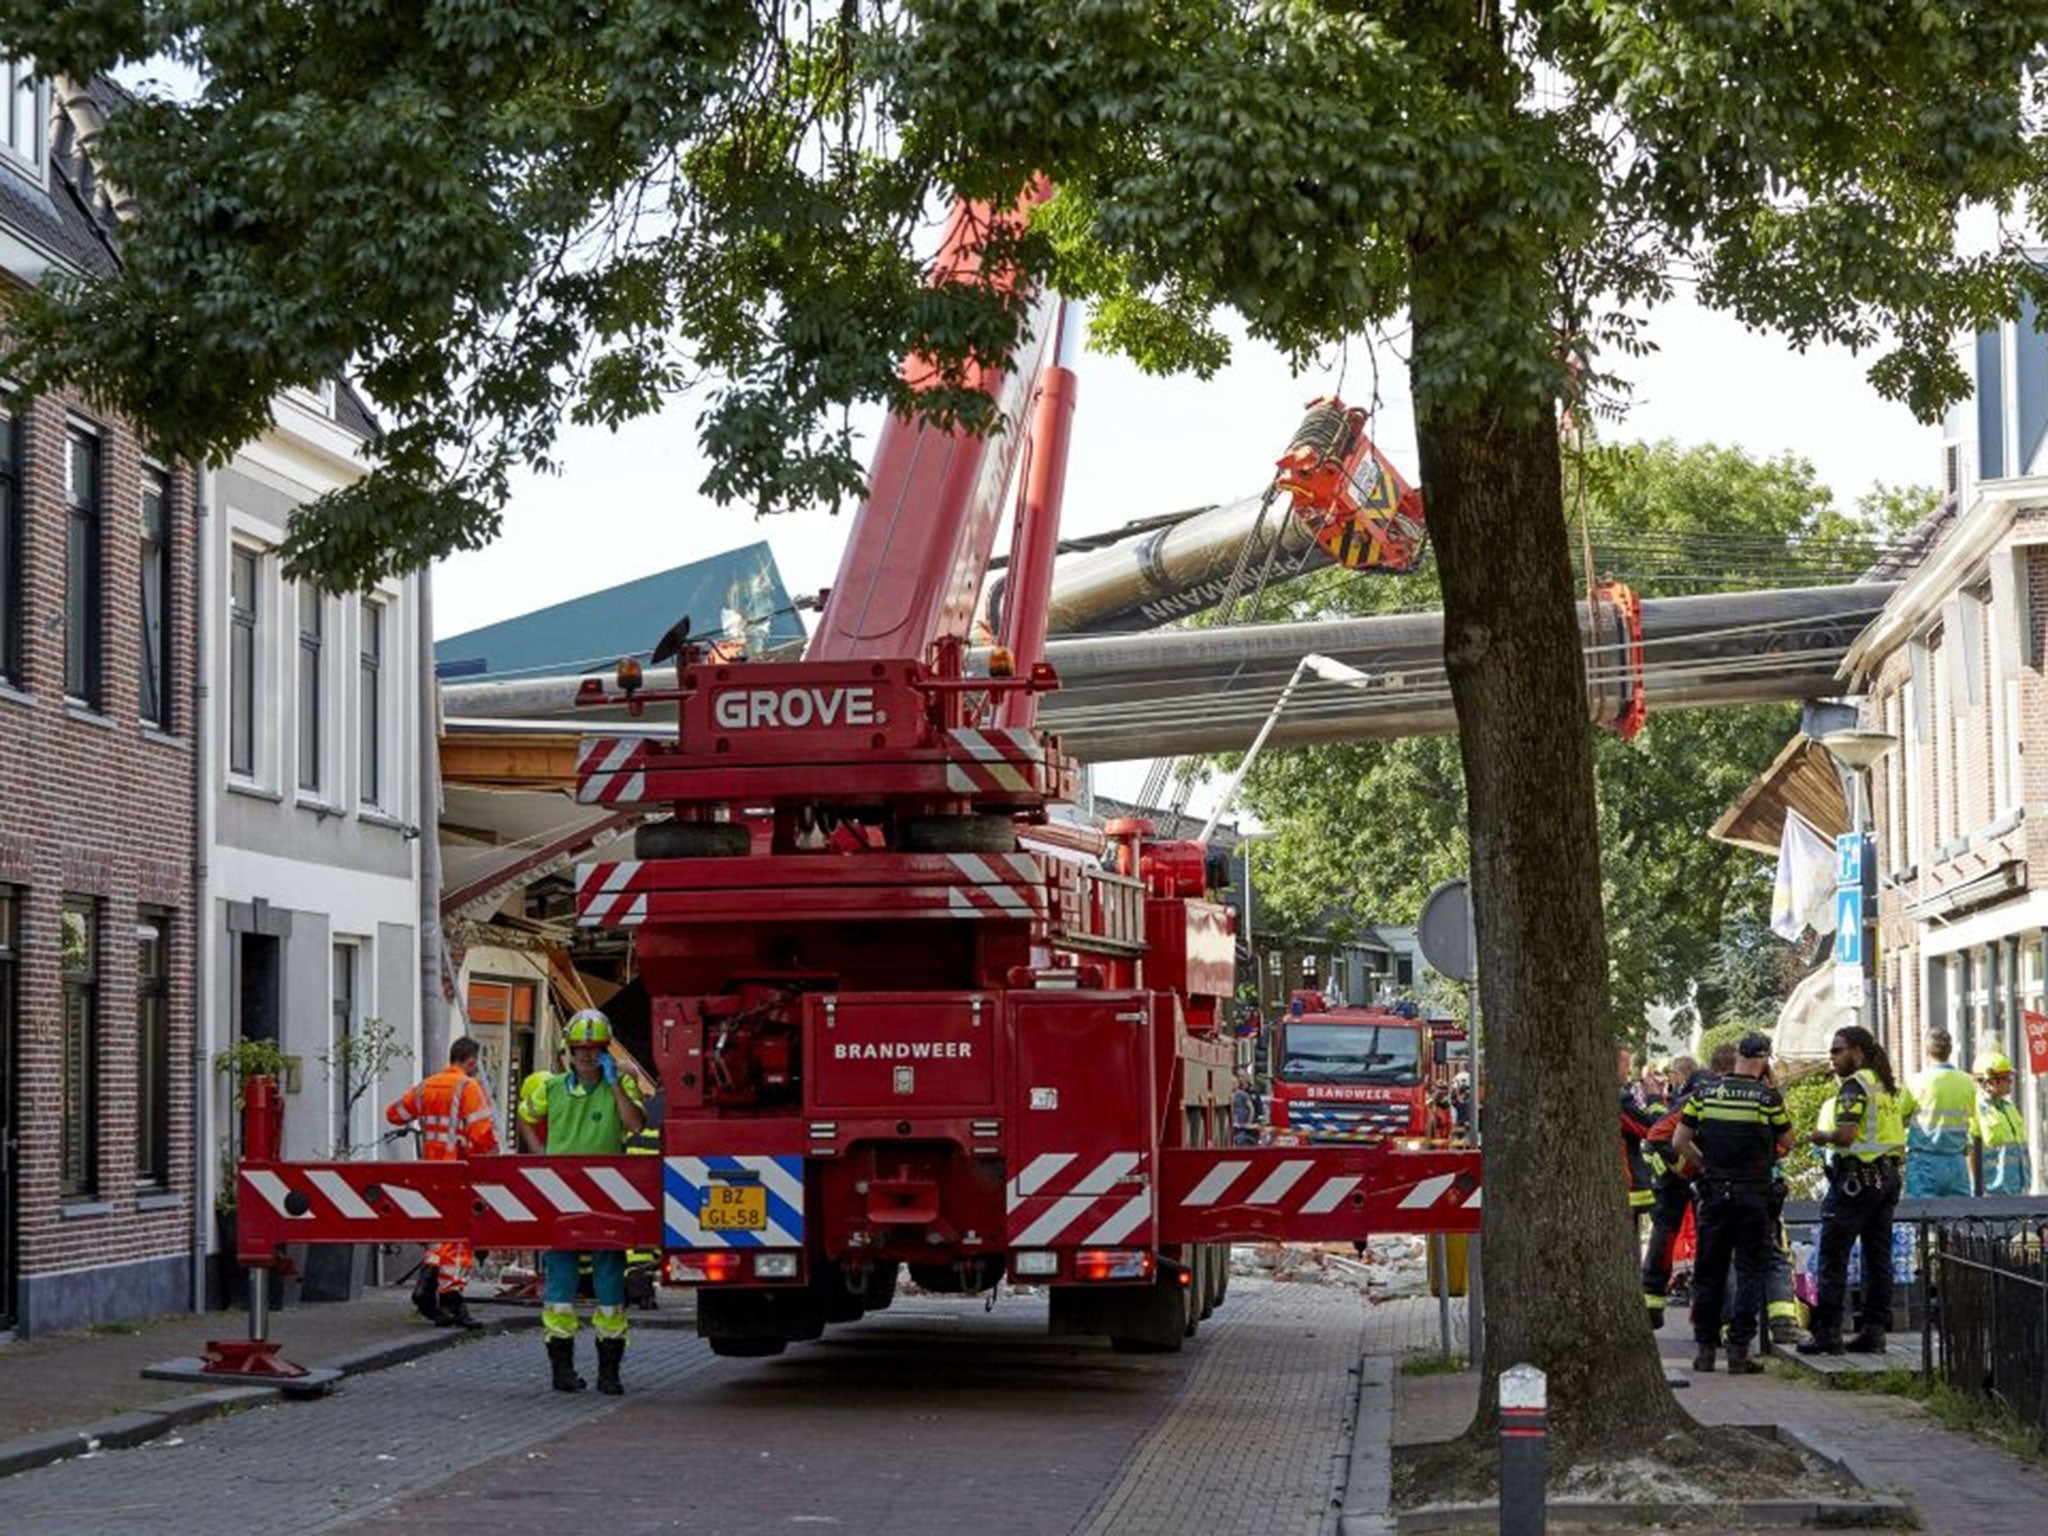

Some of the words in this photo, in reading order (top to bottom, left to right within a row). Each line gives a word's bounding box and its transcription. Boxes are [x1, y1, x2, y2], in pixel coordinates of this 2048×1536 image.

[715, 687, 874, 729] GROVE
[834, 1042, 973, 1059] BRANDWEER
[1307, 1087, 1391, 1099] BRANDWEER
[722, 1187, 744, 1204] BZ
[708, 1208, 760, 1225] GL-58
